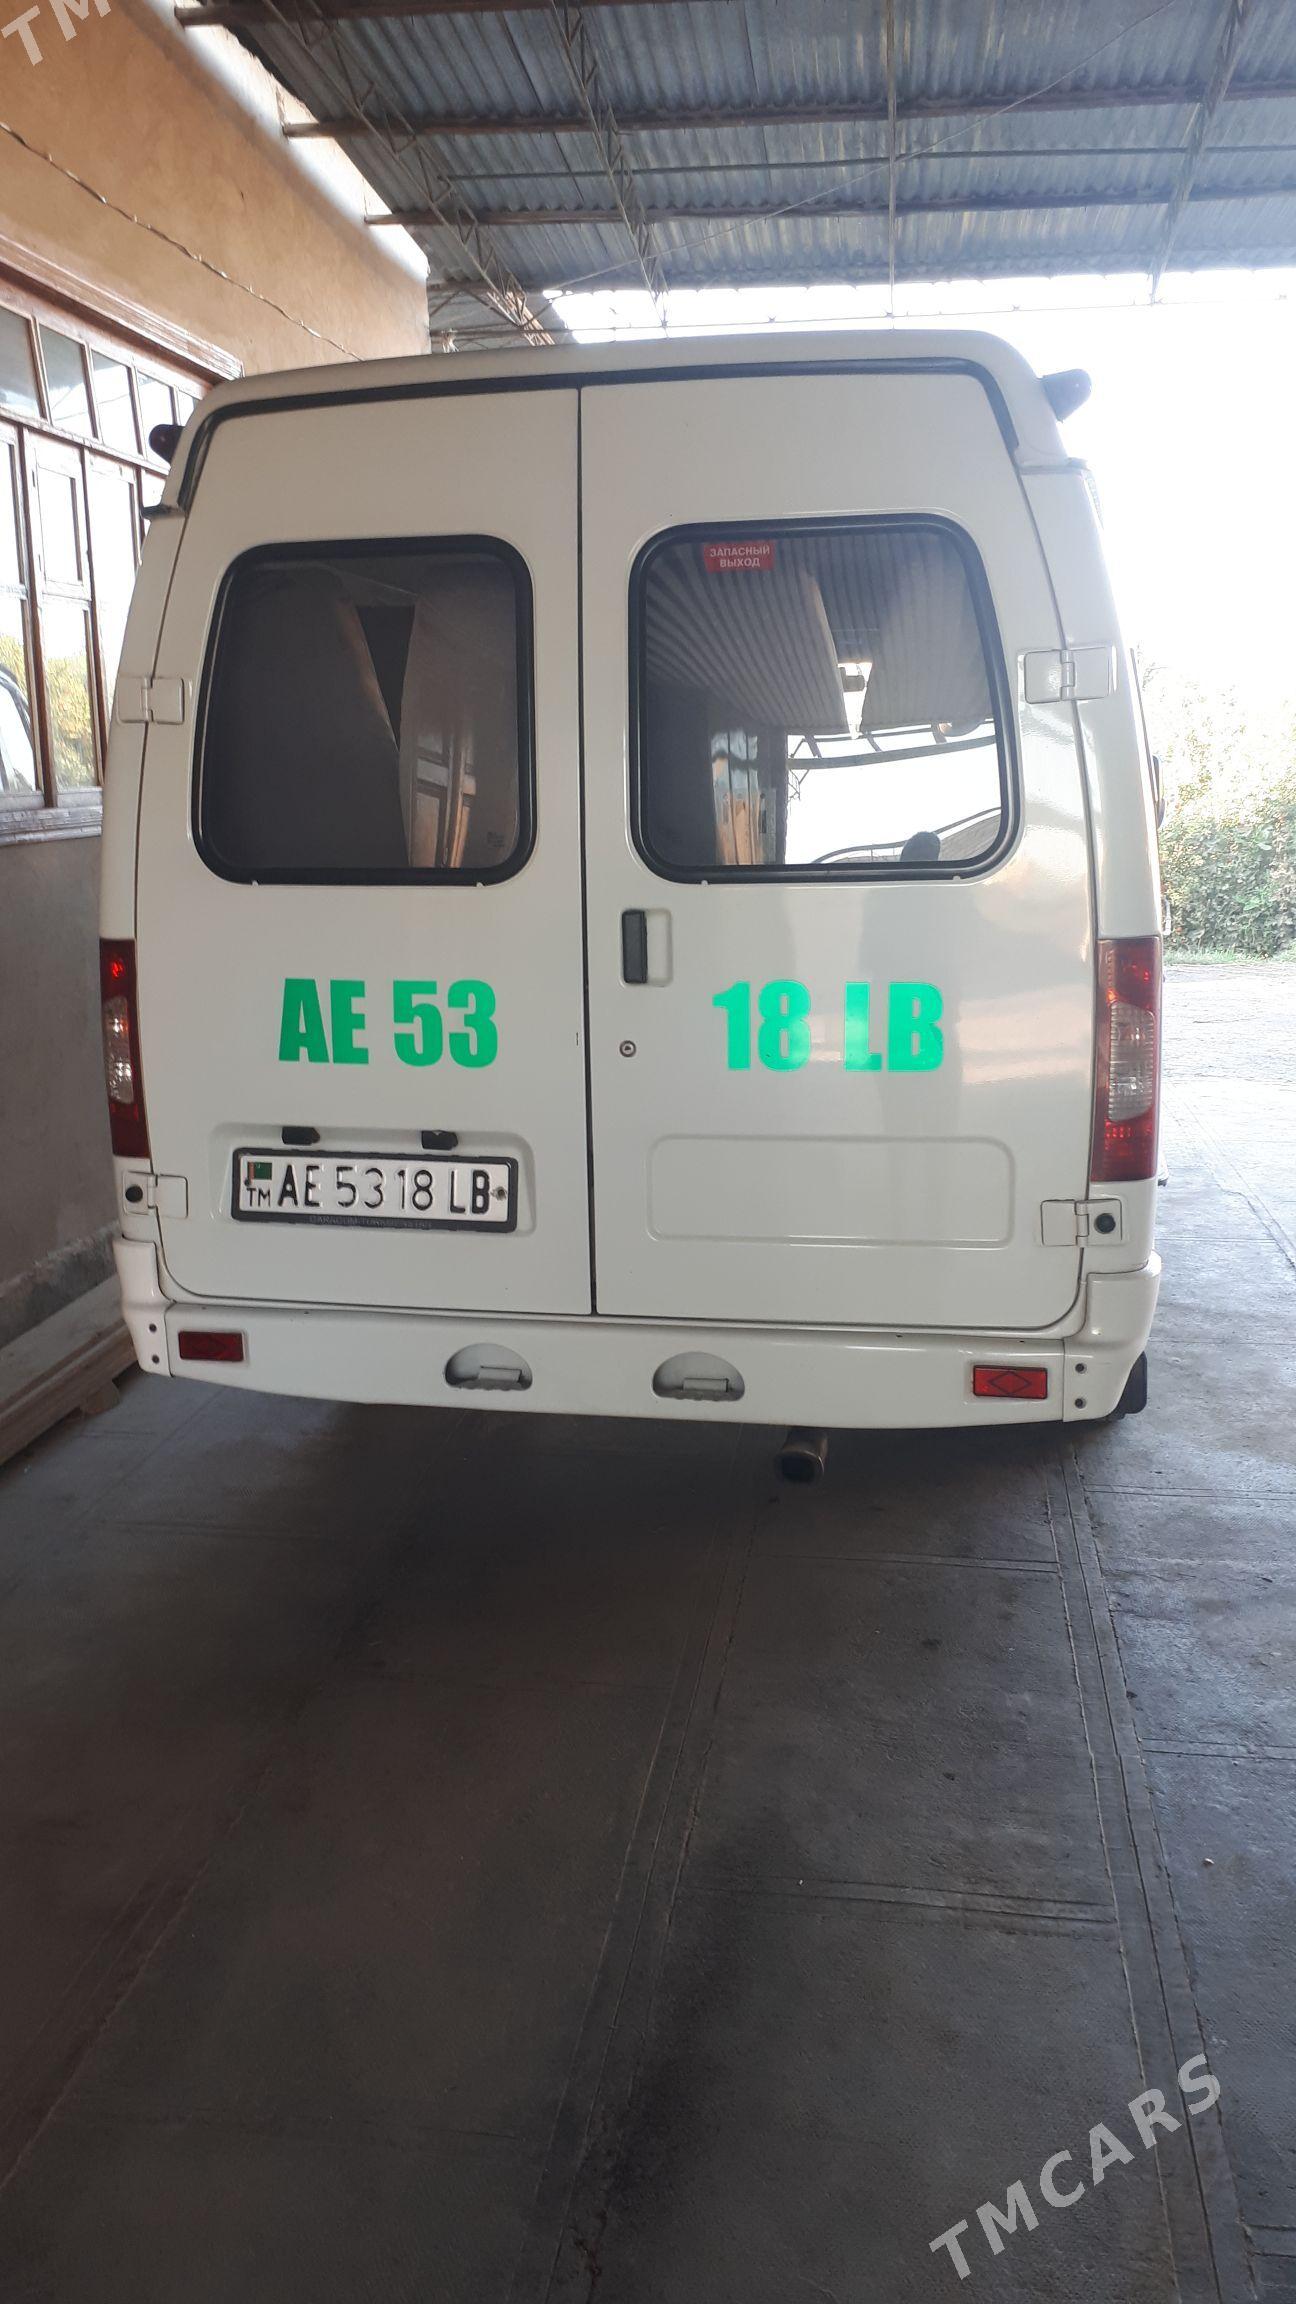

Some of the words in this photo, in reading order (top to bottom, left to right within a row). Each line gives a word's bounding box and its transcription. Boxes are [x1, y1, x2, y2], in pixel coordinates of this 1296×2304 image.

[710, 544, 770, 557] ЗАПАСНЫЙ
[720, 558, 761, 568] ВЫХОД
[279, 978, 369, 1065] AE
[393, 979, 498, 1069] 53
[712, 979, 811, 1072] 18
[844, 981, 944, 1072] LB
[247, 1187, 271, 1207] TM
[278, 1164, 321, 1207] AE
[449, 1169, 490, 1214] LB
